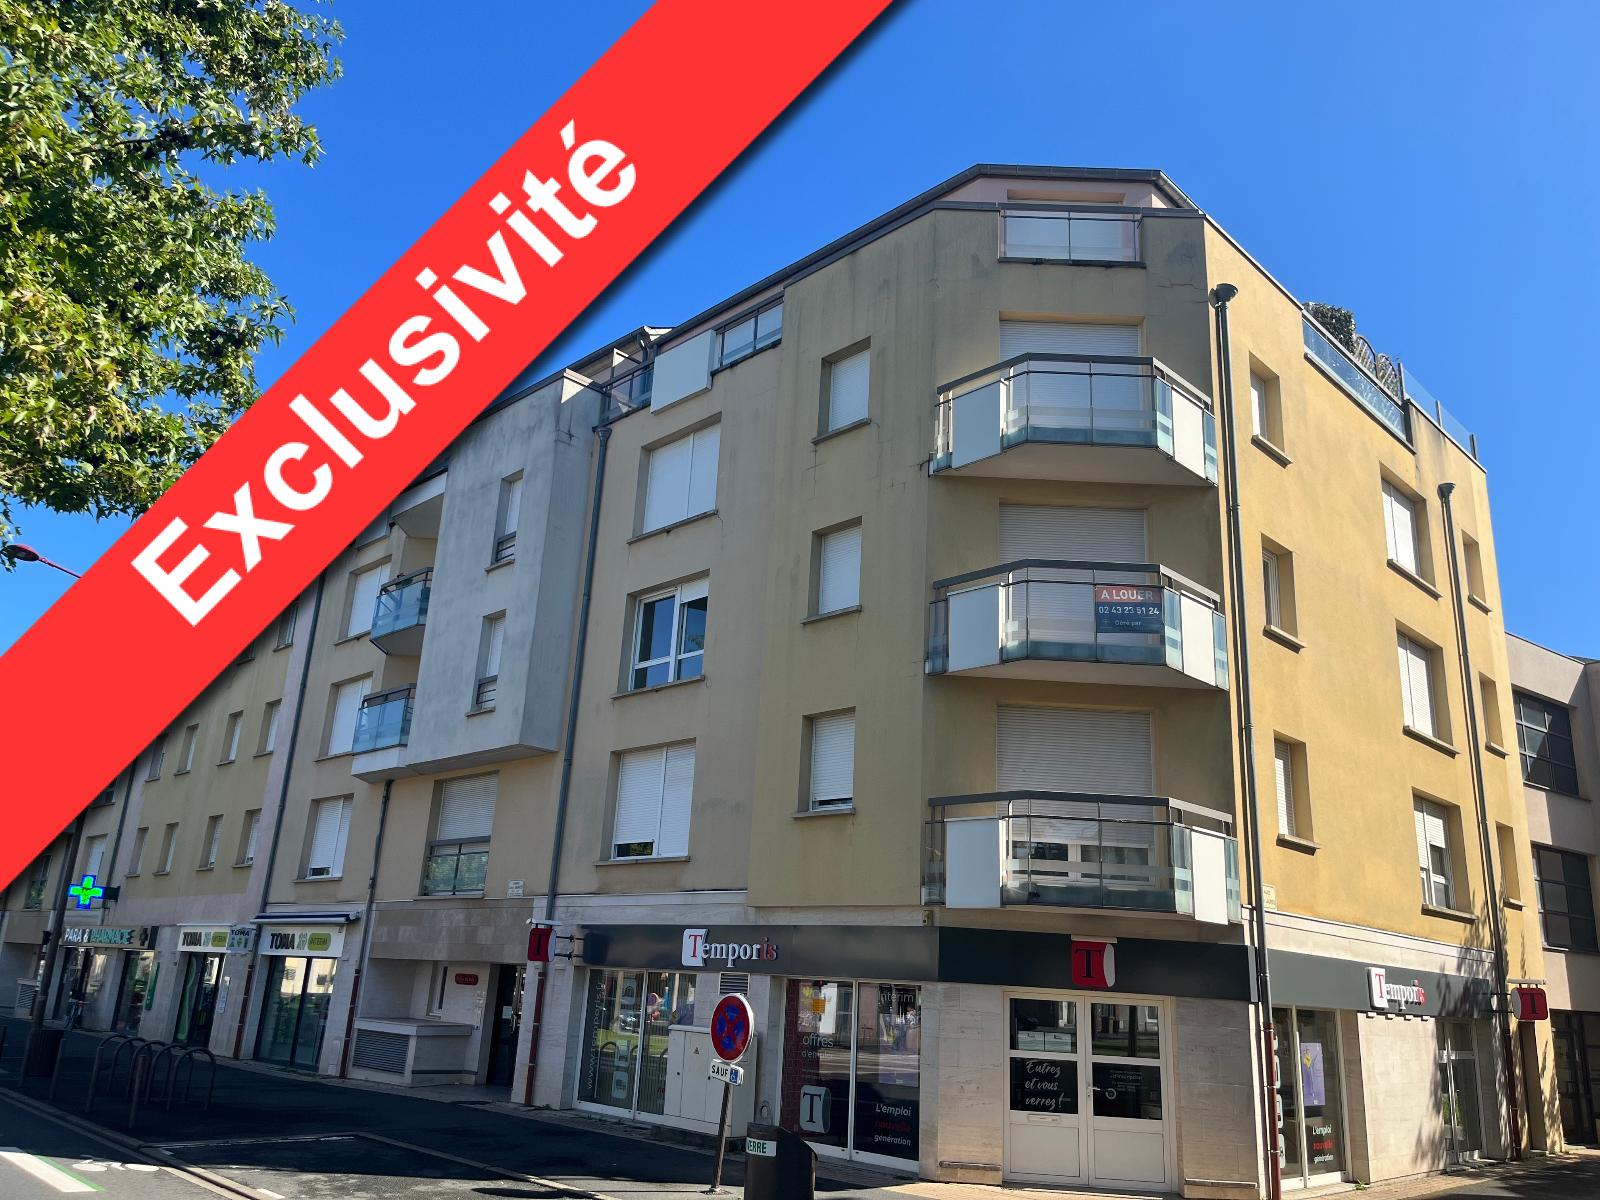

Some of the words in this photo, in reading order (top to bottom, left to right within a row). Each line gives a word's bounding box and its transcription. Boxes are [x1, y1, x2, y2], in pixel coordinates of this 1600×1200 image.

[1101, 589, 1110, 599] A
[1112, 589, 1154, 600] LOUER
[1098, 606, 1110, 614] 02
[1111, 606, 1122, 614] 43
[1123, 606, 1135, 614] 23
[1148, 607, 1160, 615] 24
[64, 928, 83, 942] PARA
[688, 934, 778, 968] Temporis
[1075, 948, 1102, 979] T
[1375, 973, 1425, 1010] Temporis
[1522, 992, 1544, 1015] T
[802, 1033, 834, 1048] offres
[711, 1064, 729, 1077] SAUF
[1025, 1061, 1061, 1078] Entrez
[1025, 1078, 1039, 1089] et
[1037, 1081, 1059, 1091] vous
[802, 1091, 822, 1123] T
[875, 1103, 912, 1117] L'emploi
[874, 1133, 911, 1146] génération
